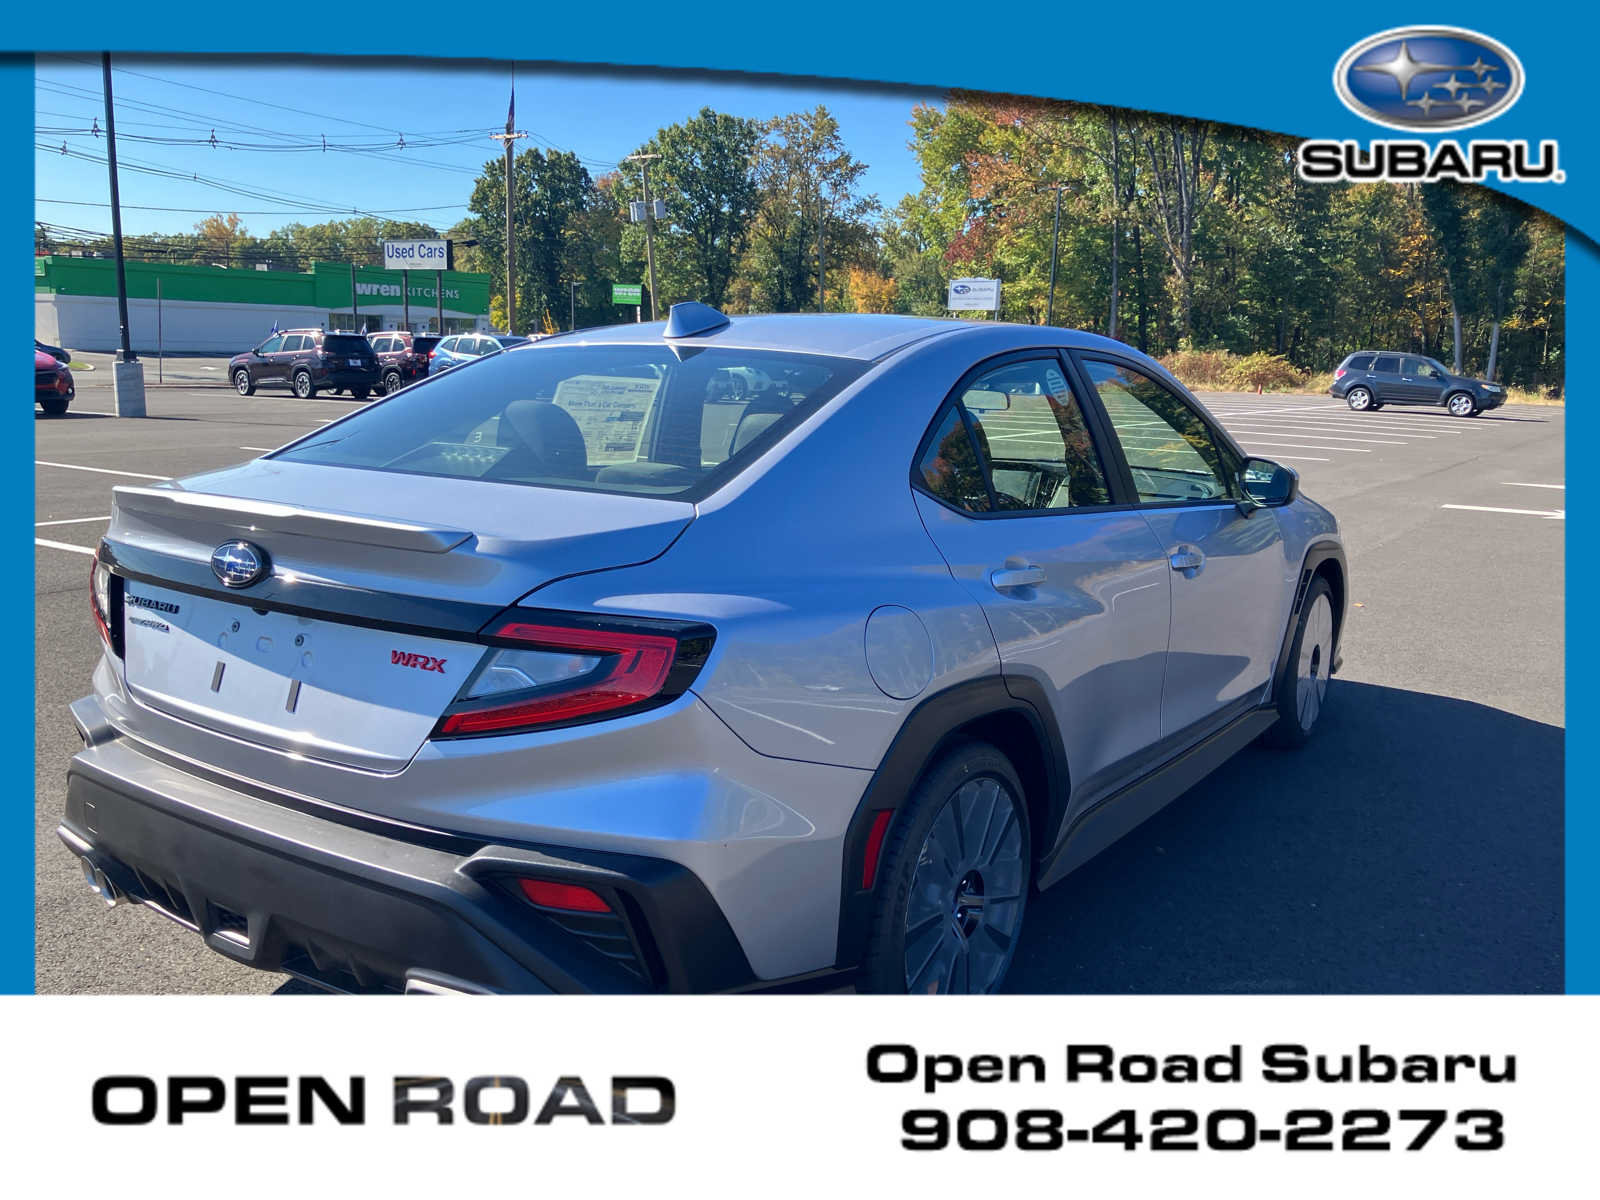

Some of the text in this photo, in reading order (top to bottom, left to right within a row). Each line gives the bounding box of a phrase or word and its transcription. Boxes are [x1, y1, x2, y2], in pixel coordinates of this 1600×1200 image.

[386, 243, 445, 258] Used Cars
[356, 283, 460, 299] wren KITCHENS
[391, 650, 447, 673] WRX
